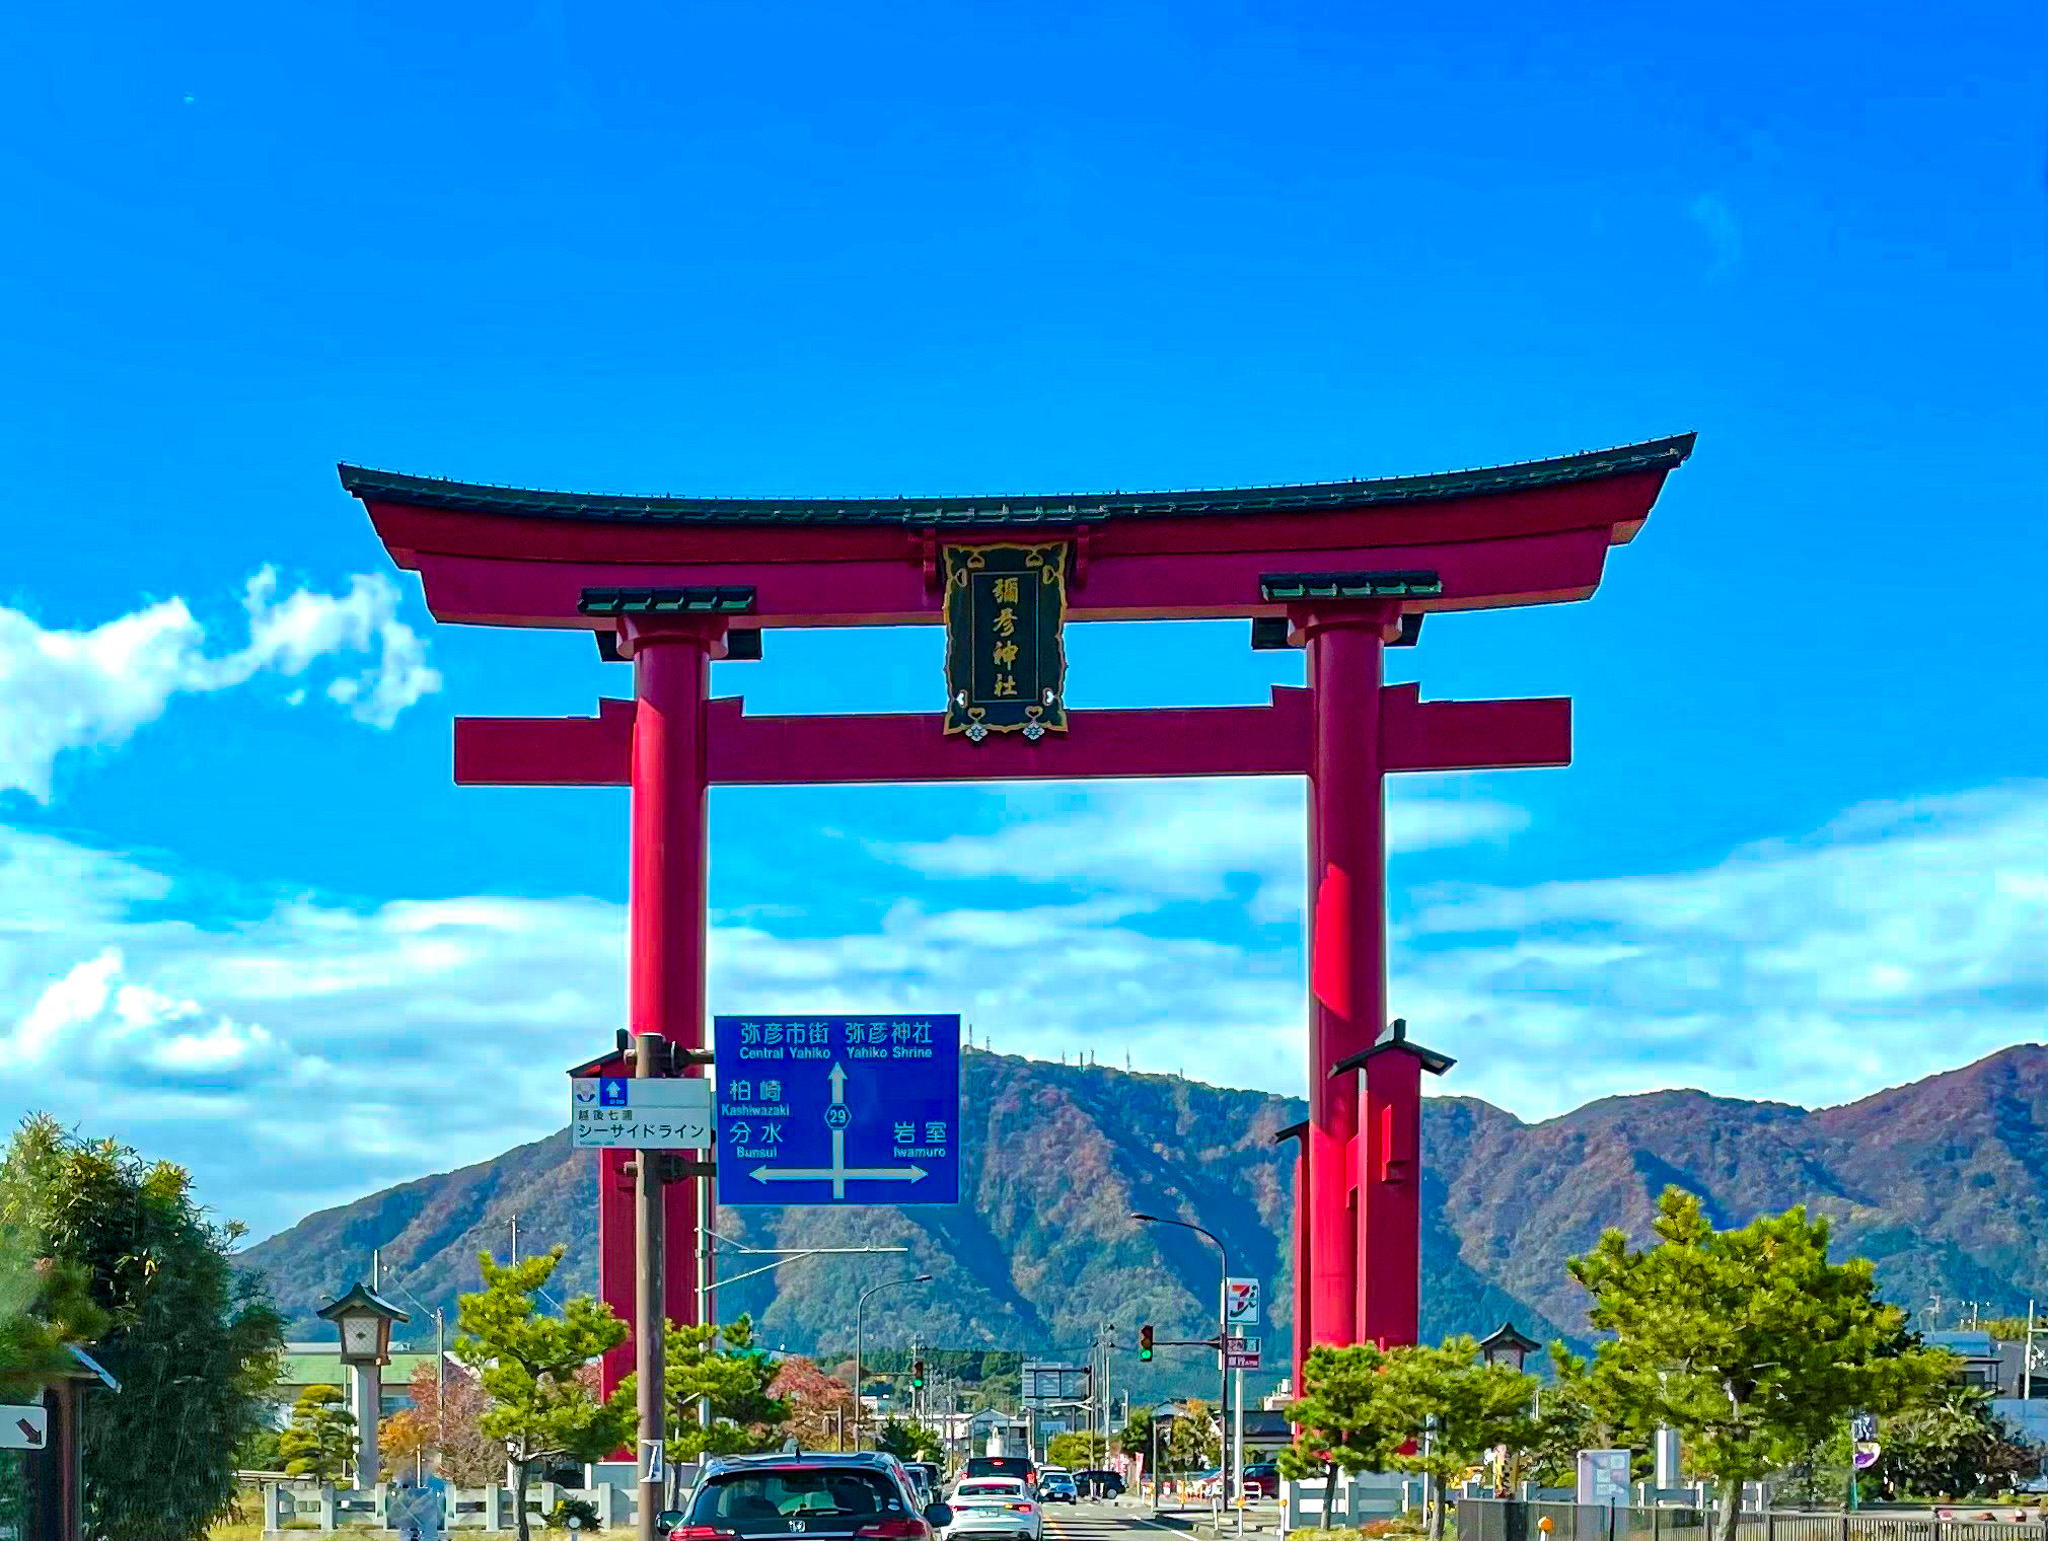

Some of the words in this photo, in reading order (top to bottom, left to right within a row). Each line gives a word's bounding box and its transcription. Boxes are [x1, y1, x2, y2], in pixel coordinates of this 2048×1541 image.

[741, 1022, 829, 1045] 弥彦市街
[845, 1021, 933, 1044] 弥彦神社
[740, 1047, 783, 1059] Central
[789, 1047, 831, 1059] Yahiko
[846, 1046, 888, 1059] Yahiko
[892, 1046, 932, 1058] Shrine
[721, 1103, 790, 1116] Kashiwazaki
[829, 1109, 847, 1123] 29
[579, 1123, 704, 1139] シーサイドライン
[729, 1121, 783, 1143] 分水
[894, 1121, 947, 1143] 岩室
[736, 1146, 777, 1158] Bunsui
[893, 1146, 946, 1158] Iwamuro
